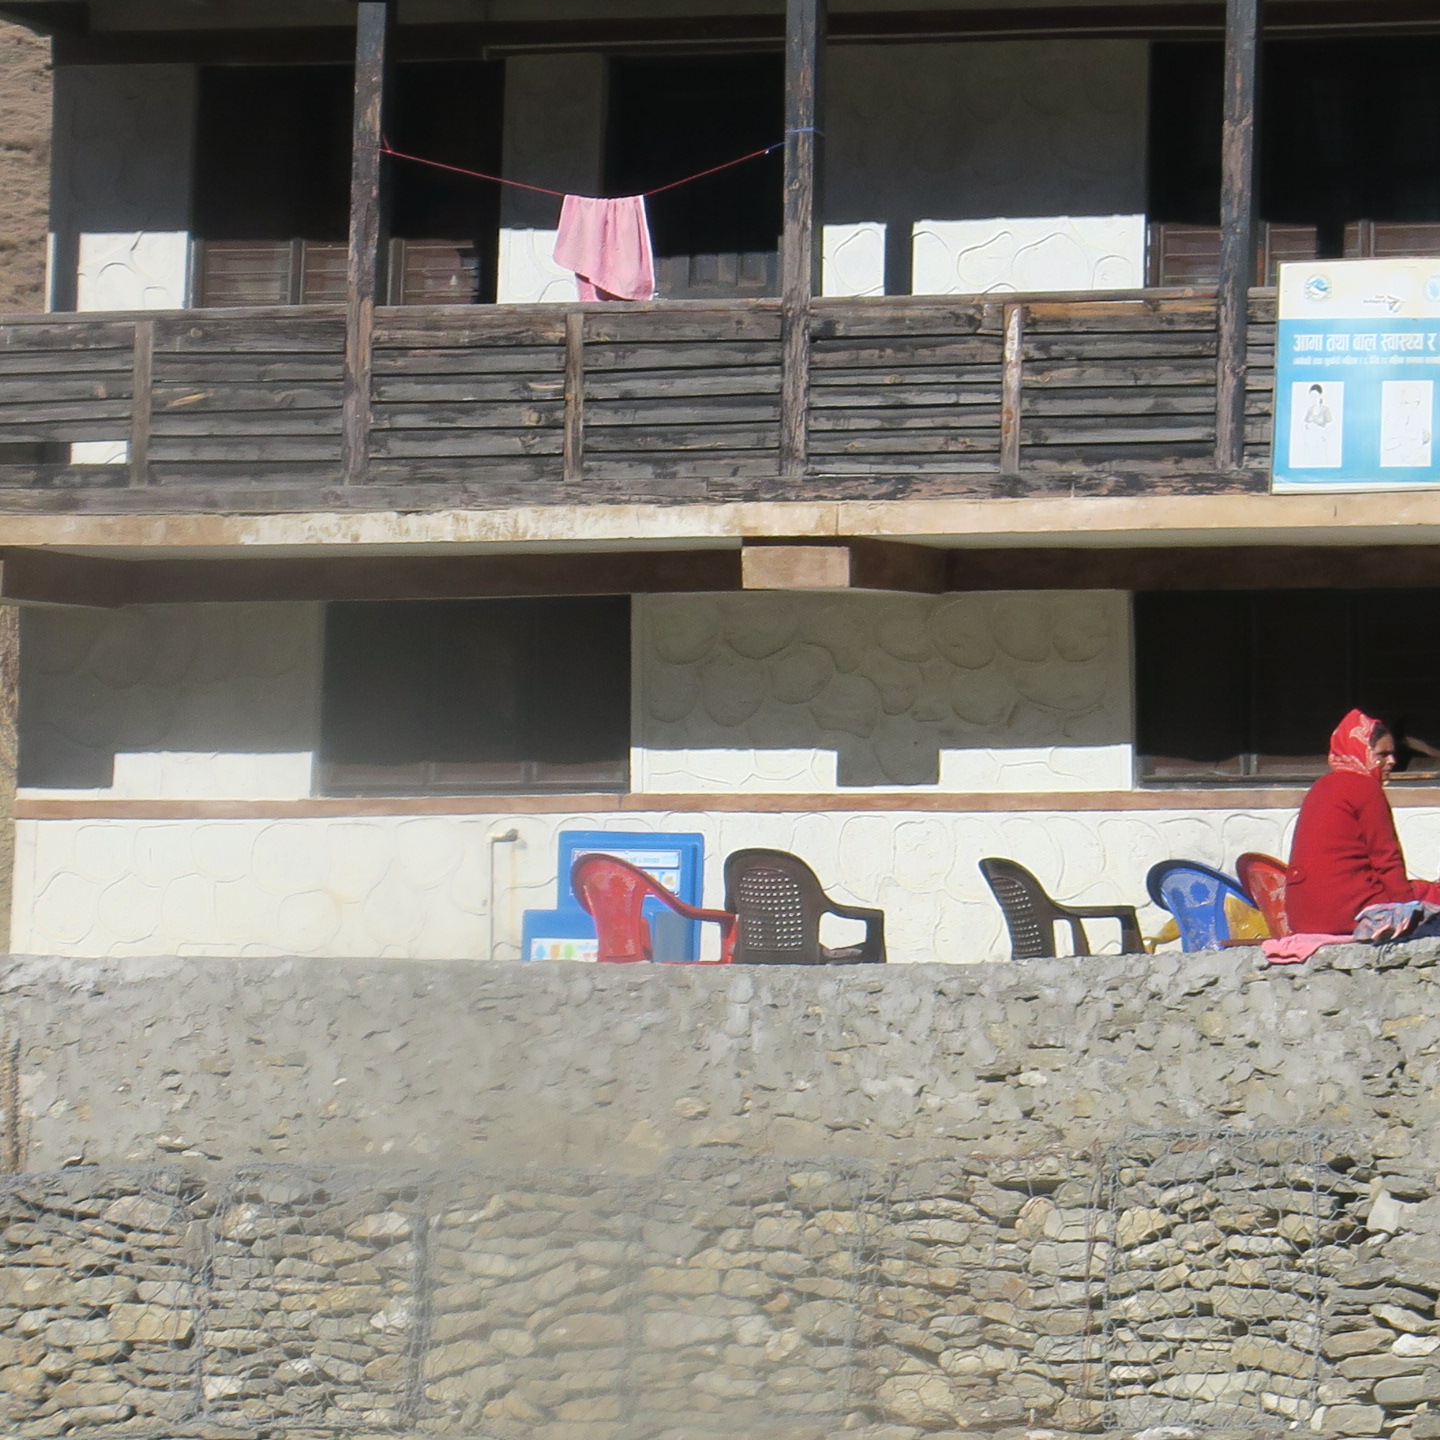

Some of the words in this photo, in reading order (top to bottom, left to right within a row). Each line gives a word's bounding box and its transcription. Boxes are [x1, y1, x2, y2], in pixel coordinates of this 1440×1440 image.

[1293, 334, 1324, 352] आमा
[1326, 333, 1350, 351] तथा
[1352, 333, 1378, 351] बाल
[1427, 333, 1438, 351] र
